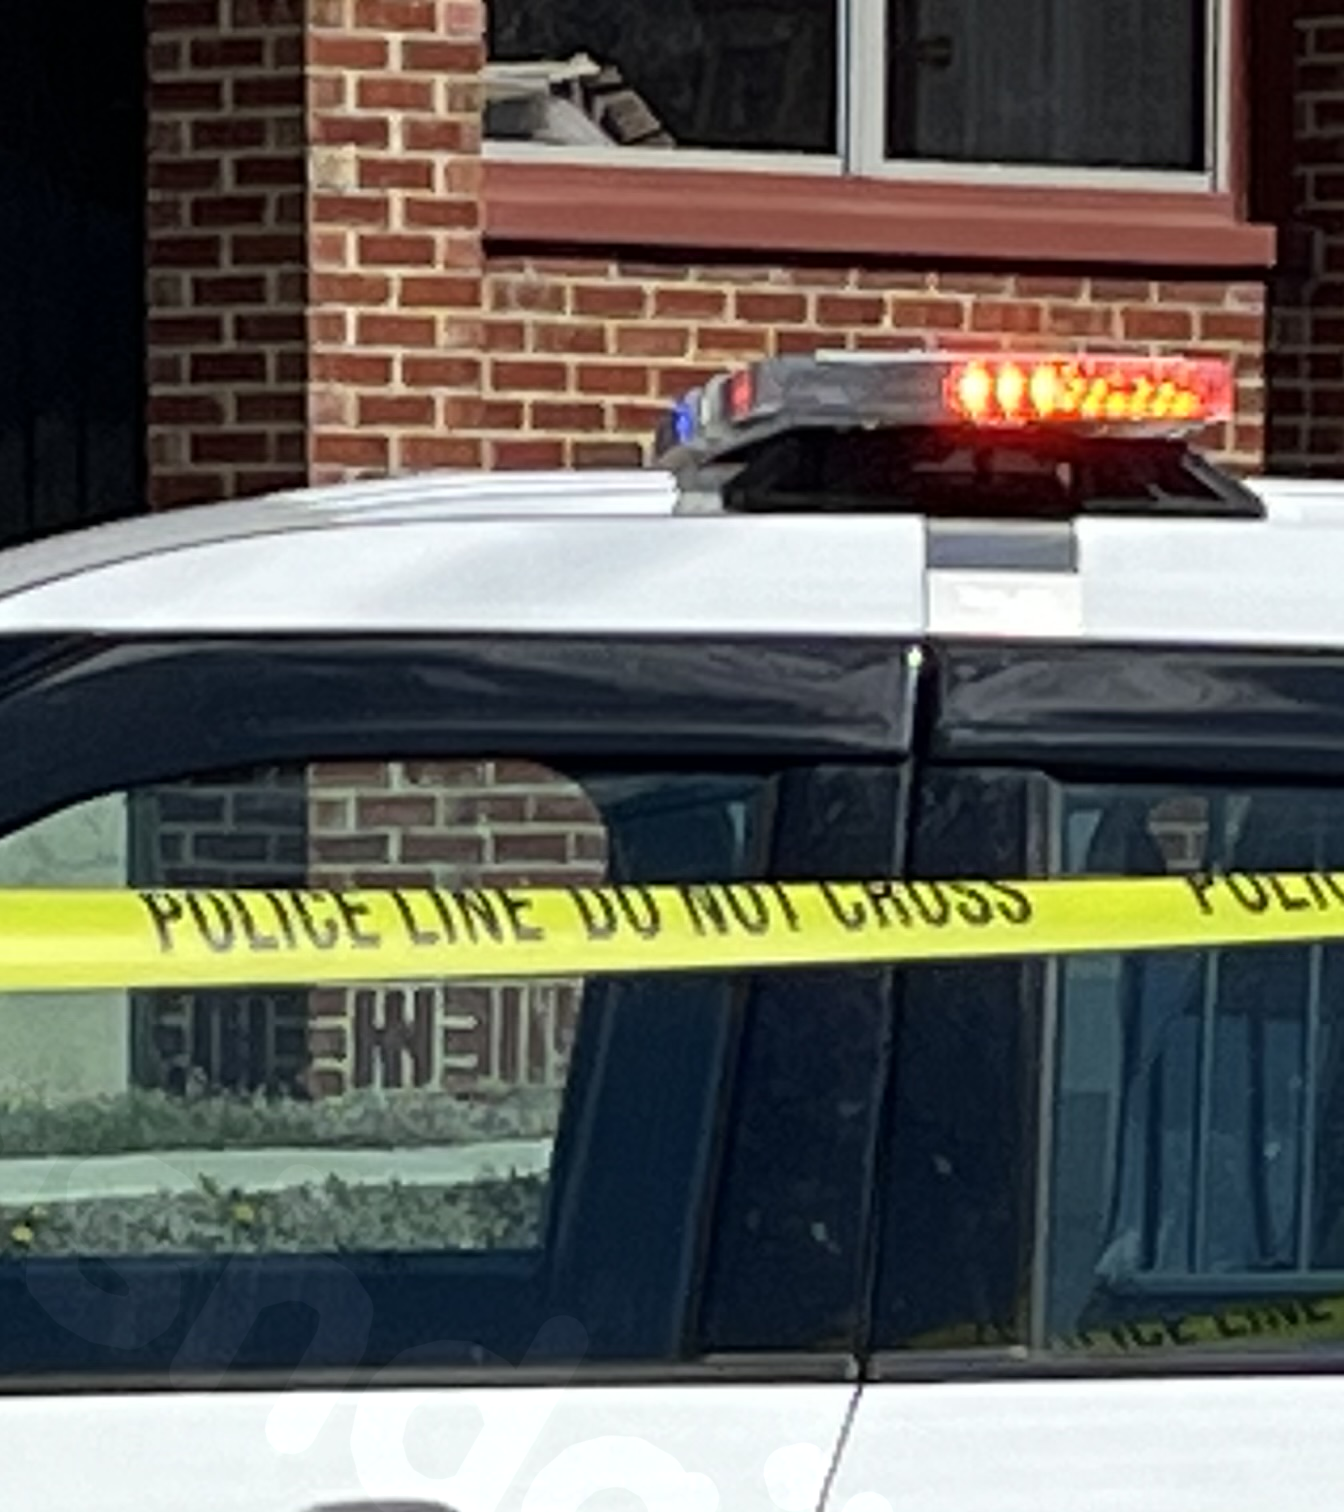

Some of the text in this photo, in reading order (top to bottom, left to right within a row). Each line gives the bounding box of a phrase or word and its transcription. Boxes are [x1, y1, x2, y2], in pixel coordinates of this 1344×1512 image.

[139, 879, 1035, 954] POLICE LINE DO NOT CROSS
